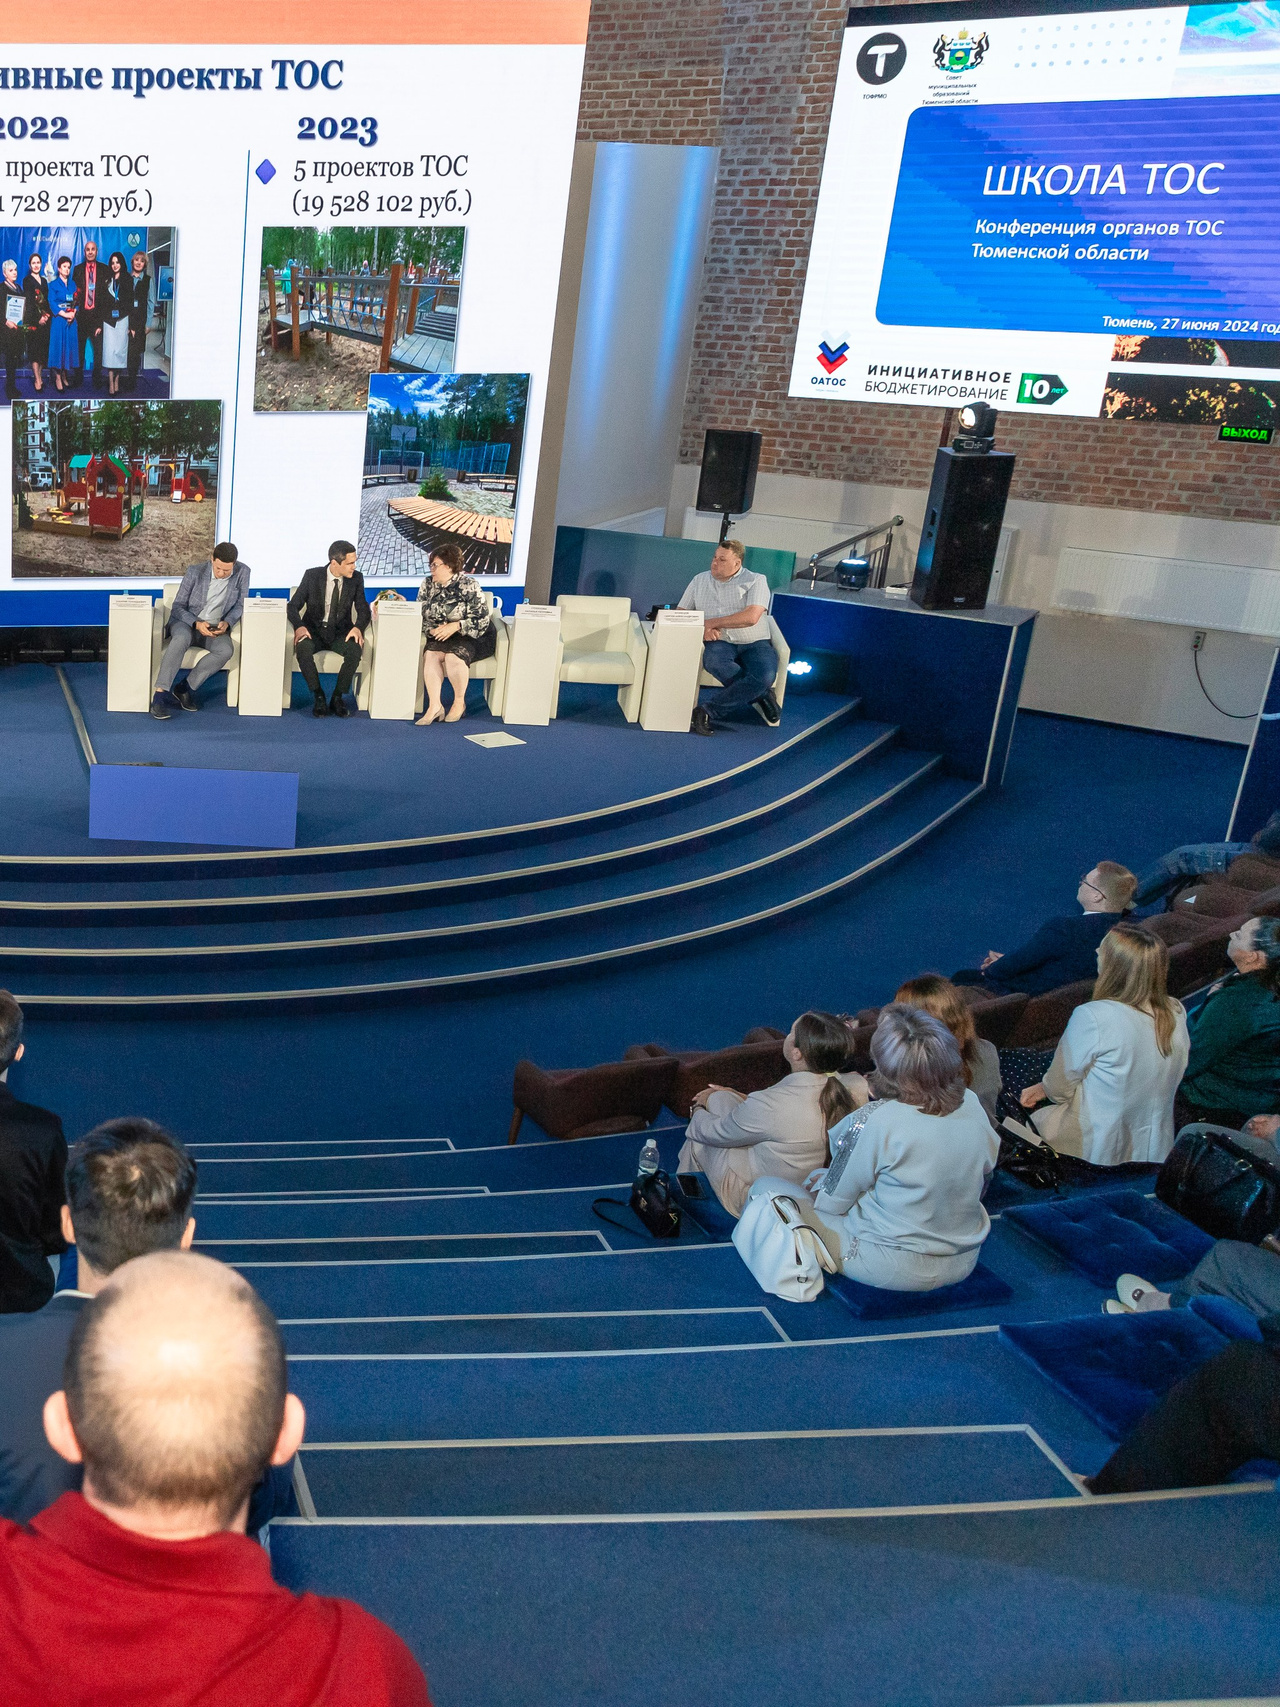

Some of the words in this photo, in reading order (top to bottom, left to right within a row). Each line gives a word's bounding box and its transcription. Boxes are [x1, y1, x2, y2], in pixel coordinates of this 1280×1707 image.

[111, 67, 263, 98] проекты
[271, 59, 344, 90] ТОС
[297, 117, 378, 147] 2023
[6, 161, 95, 183] проекта
[100, 155, 149, 177] ТОС
[294, 160, 306, 181] 5
[312, 161, 414, 183] проектов
[420, 155, 468, 177] ТОС
[982, 163, 1127, 196] ШКОЛА
[1142, 163, 1225, 196] ТОС
[11, 190, 50, 217] 728
[57, 195, 94, 217] 277
[99, 189, 153, 218] руб.)
[293, 189, 324, 217] (19
[330, 190, 369, 217] 528
[376, 195, 413, 212] 102
[418, 189, 472, 218] руб.)
[975, 219, 1096, 238] Конференция
[1102, 221, 1180, 238] органов
[1185, 220, 1225, 236] ТОС
[972, 243, 1070, 260] Тюменской
[1074, 244, 1149, 261] области
[1102, 316, 1158, 331] Тюмень,
[1161, 318, 1180, 331] 27
[1181, 319, 1220, 331] июня
[1222, 320, 1259, 332] 2024
[811, 376, 847, 387] ОАТОС
[867, 364, 1012, 384] ИНИЦИАТИВНОЕ
[864, 380, 1009, 400] БЮДЖЕТИРОВАНИЕ
[1024, 379, 1050, 399] 10
[1222, 427, 1268, 441] ВЫХОД
